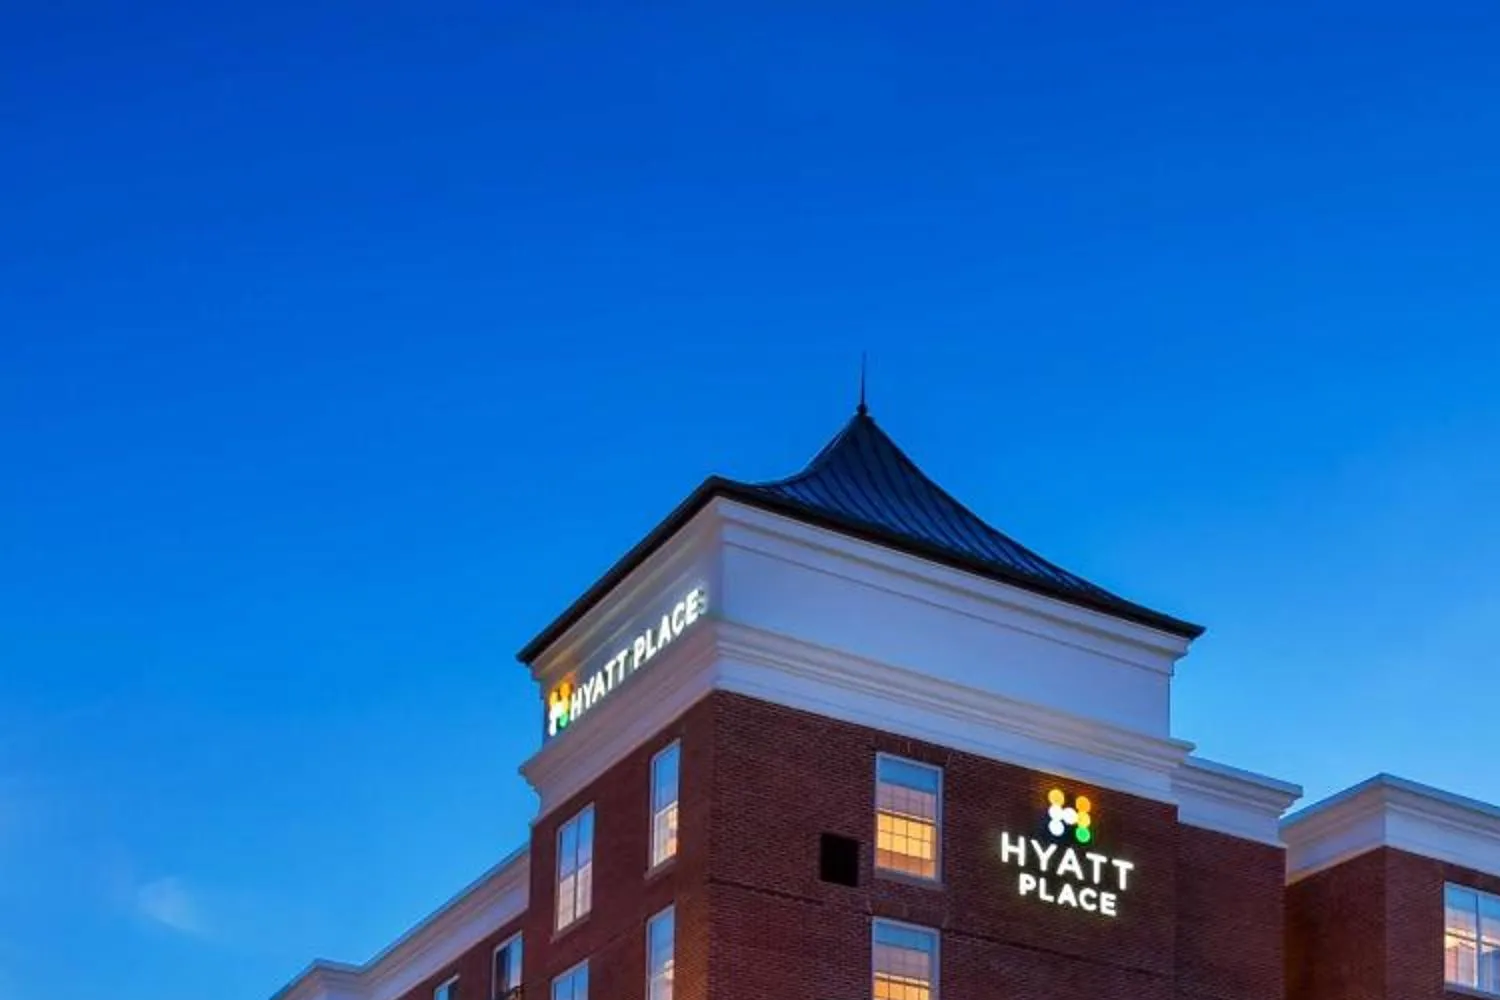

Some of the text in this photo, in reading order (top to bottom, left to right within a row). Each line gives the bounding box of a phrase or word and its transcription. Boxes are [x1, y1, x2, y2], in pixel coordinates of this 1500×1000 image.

[570, 588, 702, 721] HYATT PLACE
[1001, 831, 1135, 891] HYATT
[1019, 872, 1117, 917] PLACE
